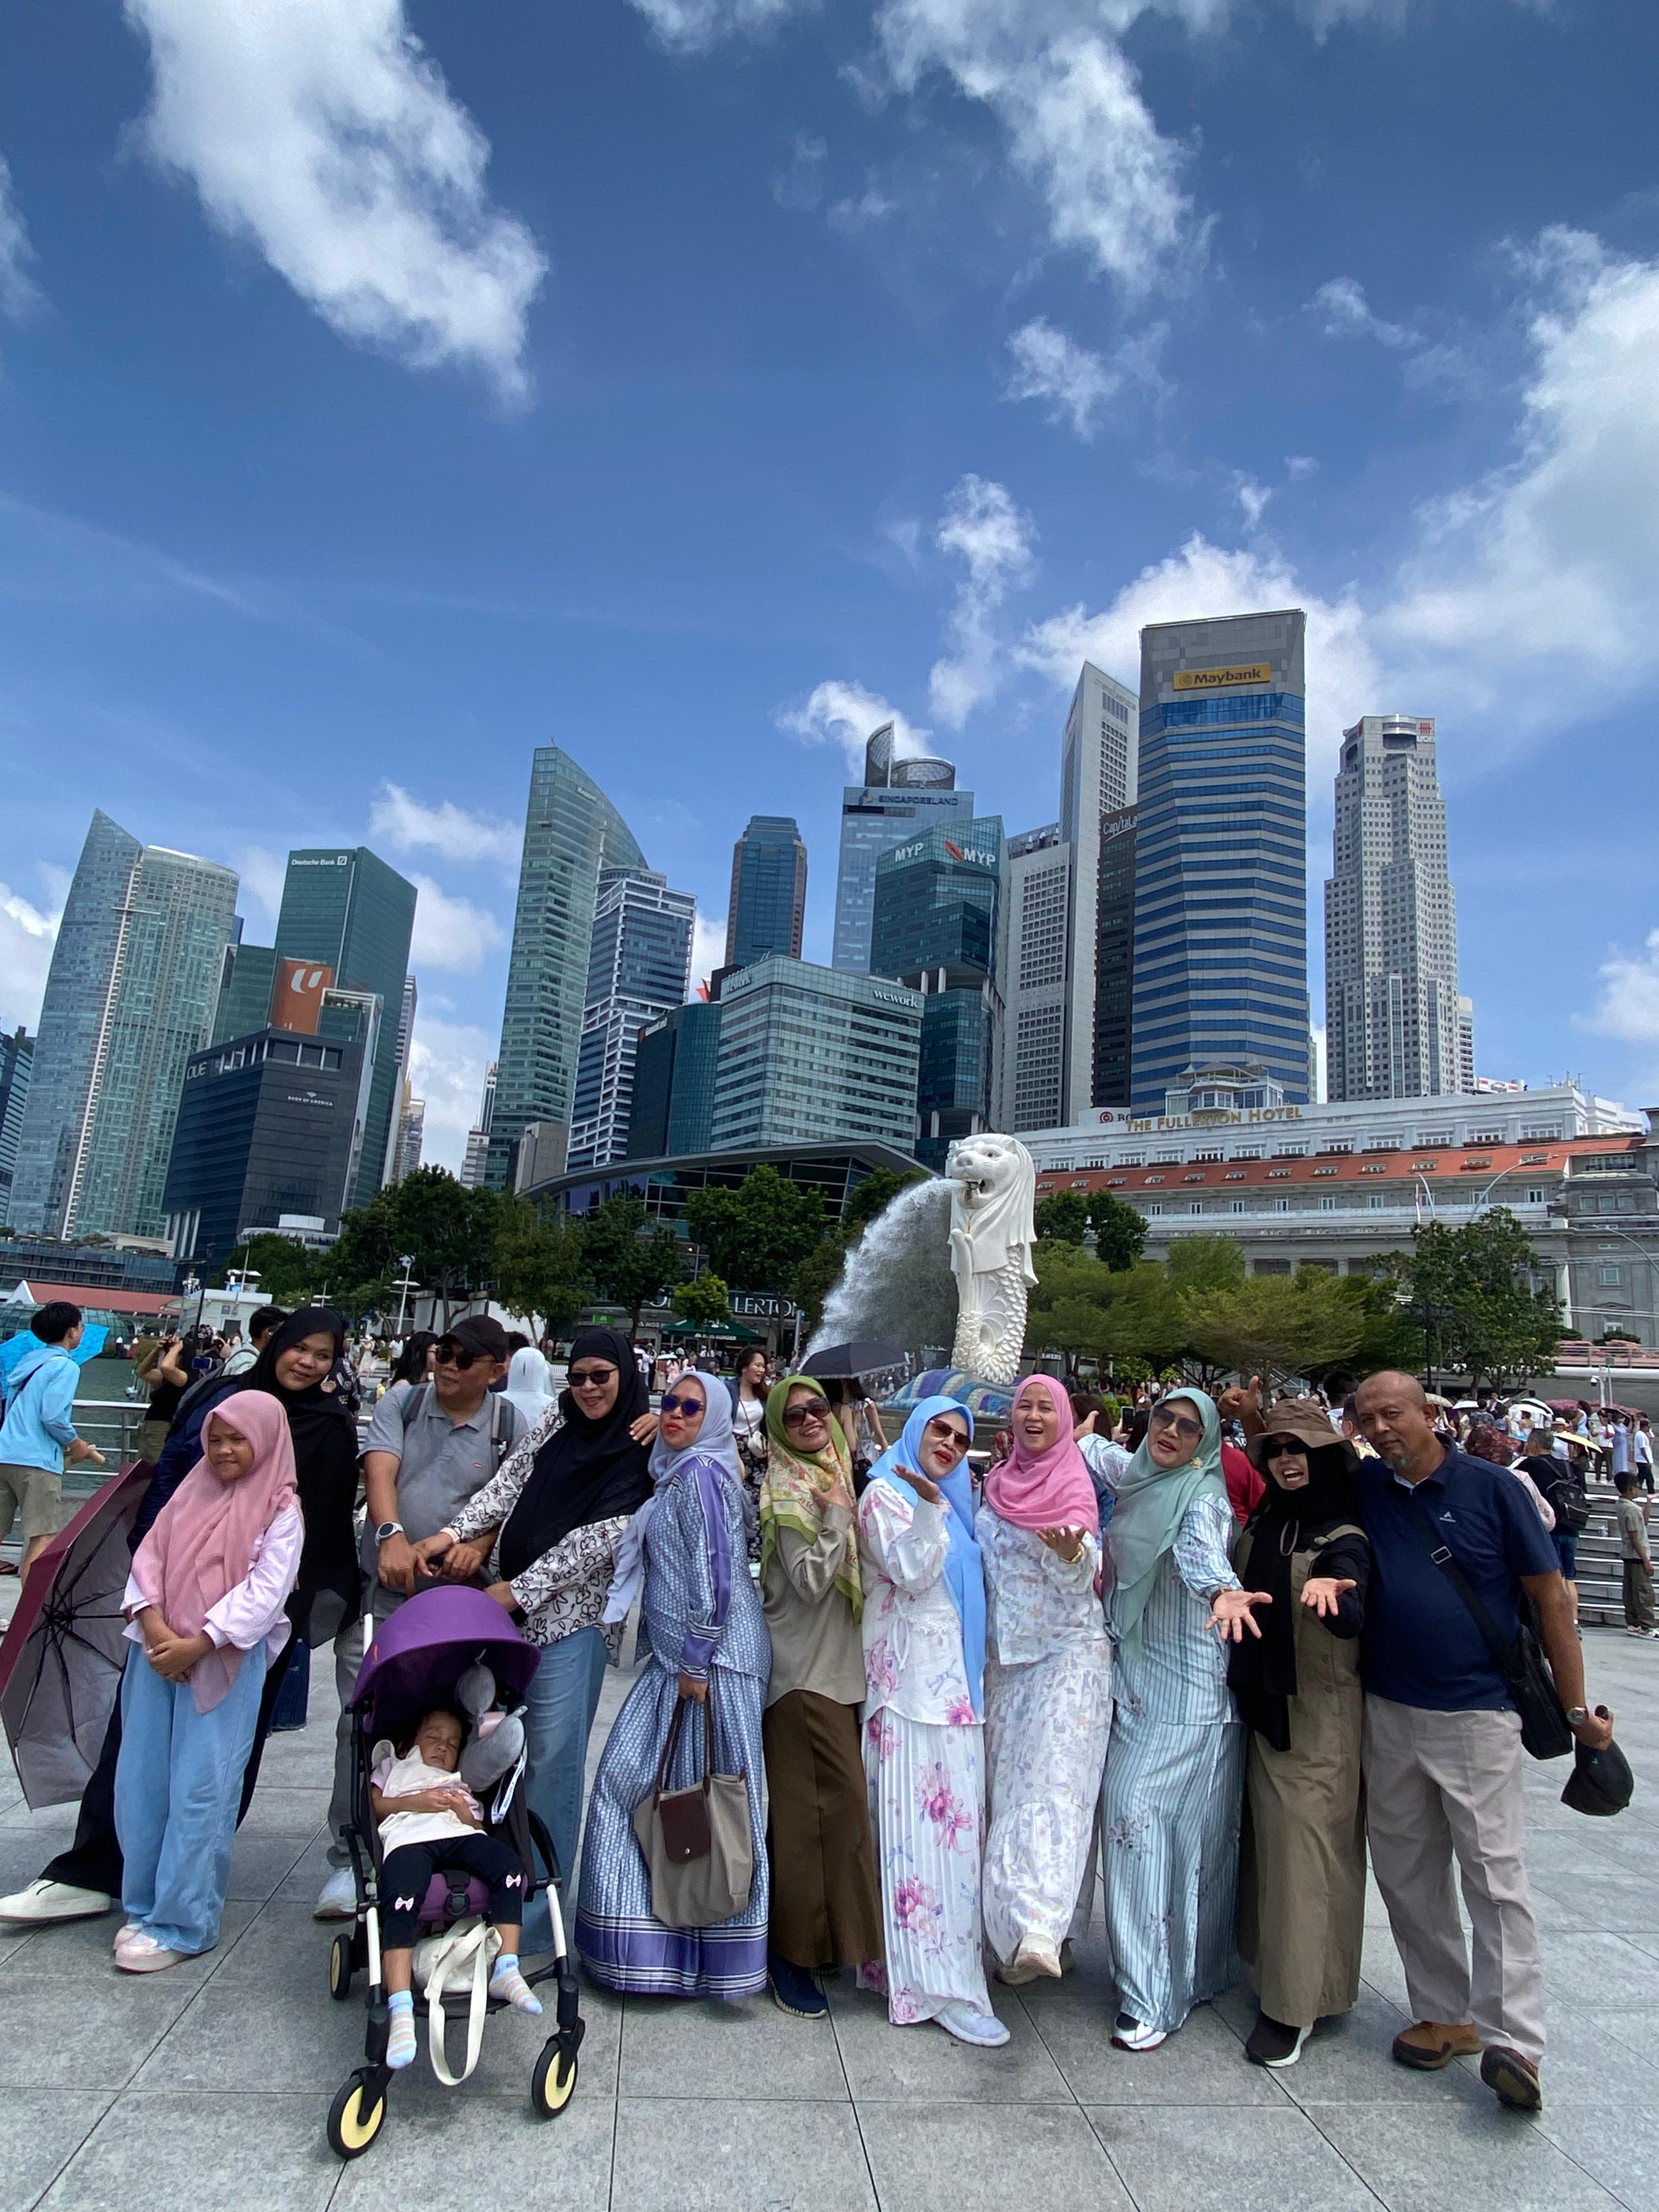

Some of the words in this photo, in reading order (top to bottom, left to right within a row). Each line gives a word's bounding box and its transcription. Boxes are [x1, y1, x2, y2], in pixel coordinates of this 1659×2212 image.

[1194, 668, 1261, 684] Maybank
[878, 795, 958, 806] SINGAPORELAND
[1103, 815, 1137, 836] CapitaLa
[895, 842, 924, 862] MYP
[964, 848, 996, 866] MYP
[873, 989, 918, 1008] wework
[1126, 1120, 1152, 1132] THE
[1158, 1111, 1242, 1130] FULLERTON
[1249, 1107, 1302, 1122] HOTEL
